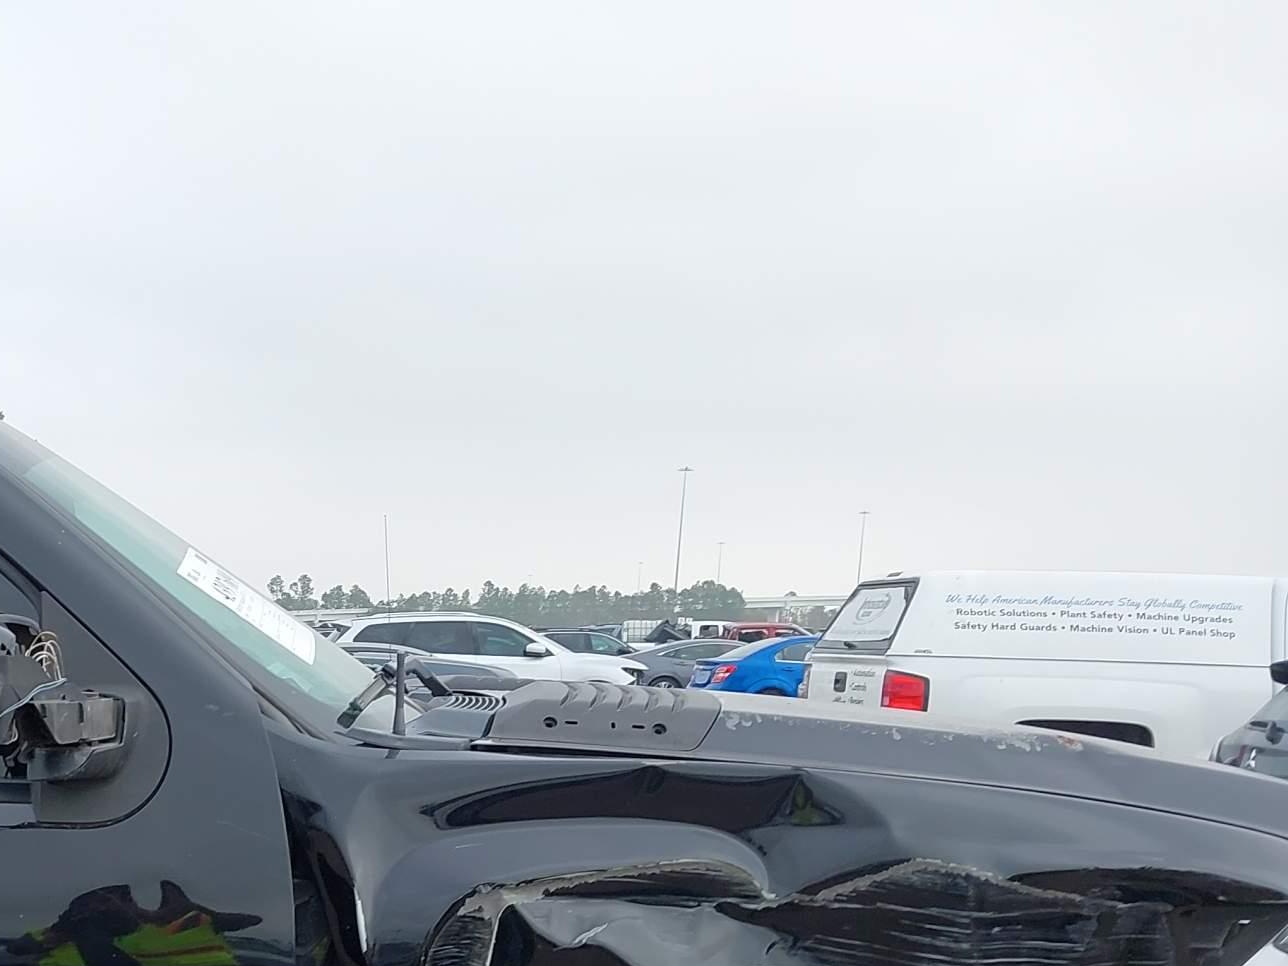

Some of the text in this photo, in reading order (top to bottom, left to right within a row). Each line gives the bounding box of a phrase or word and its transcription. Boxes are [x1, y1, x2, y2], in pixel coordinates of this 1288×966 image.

[946, 594, 1243, 612] We Help American Manufacturers Stay Globally Competitive
[956, 608, 1233, 625] Robotic Solutions Plant Safety Machine Upgrades
[954, 621, 1236, 640] Safety Hard Guards Machine Vision UL Panel Shop
